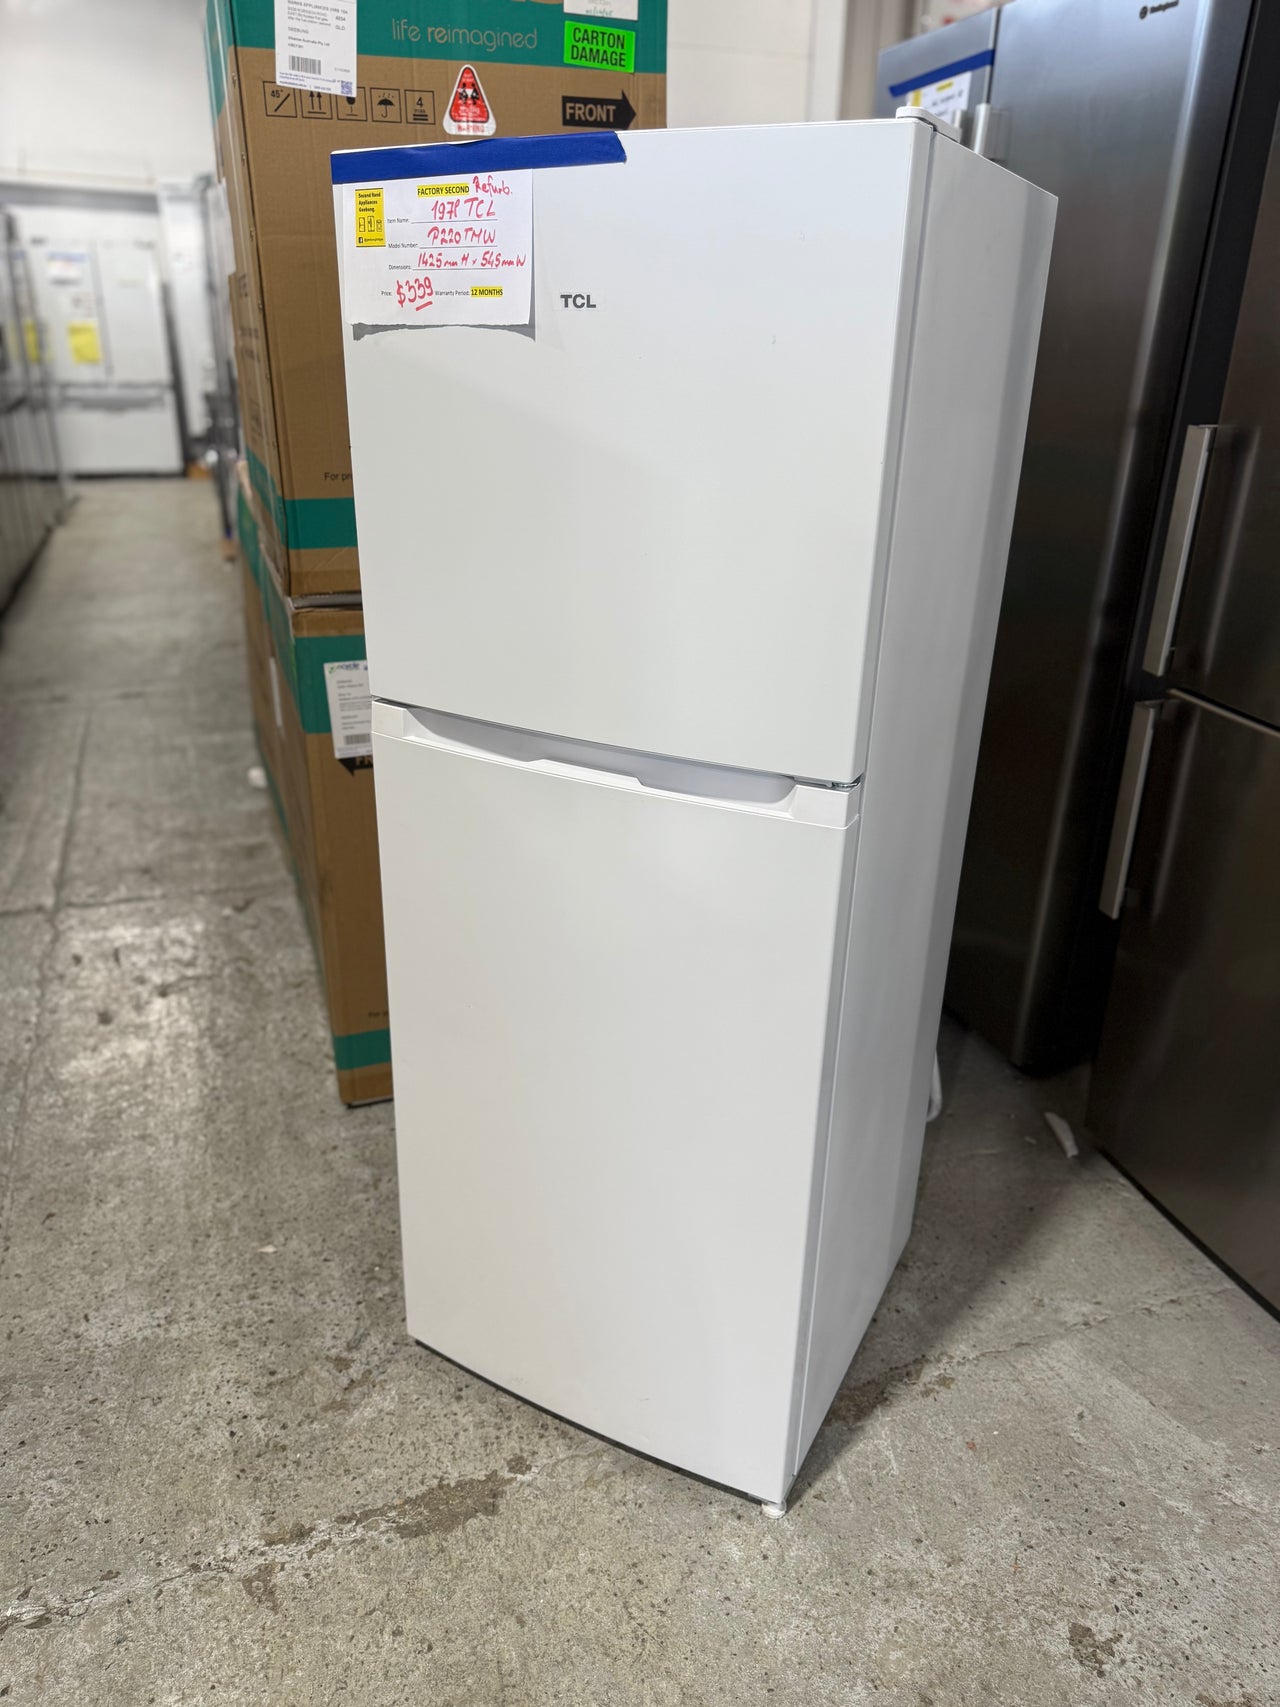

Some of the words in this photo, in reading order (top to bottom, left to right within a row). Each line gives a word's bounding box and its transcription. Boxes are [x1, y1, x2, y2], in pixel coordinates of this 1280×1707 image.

[392, 18, 421, 42] life
[427, 24, 538, 52] reimagined
[573, 27, 625, 49] CARTON
[571, 45, 626, 67] DAMAGE
[565, 102, 616, 123] FRONT
[417, 187, 444, 196] FACTORY
[444, 185, 470, 194] SECOND
[464, 197, 496, 218] TCL
[396, 276, 434, 308] $339
[478, 288, 503, 296] MONTHS
[560, 294, 596, 309] TCL
[324, 472, 339, 481] For
